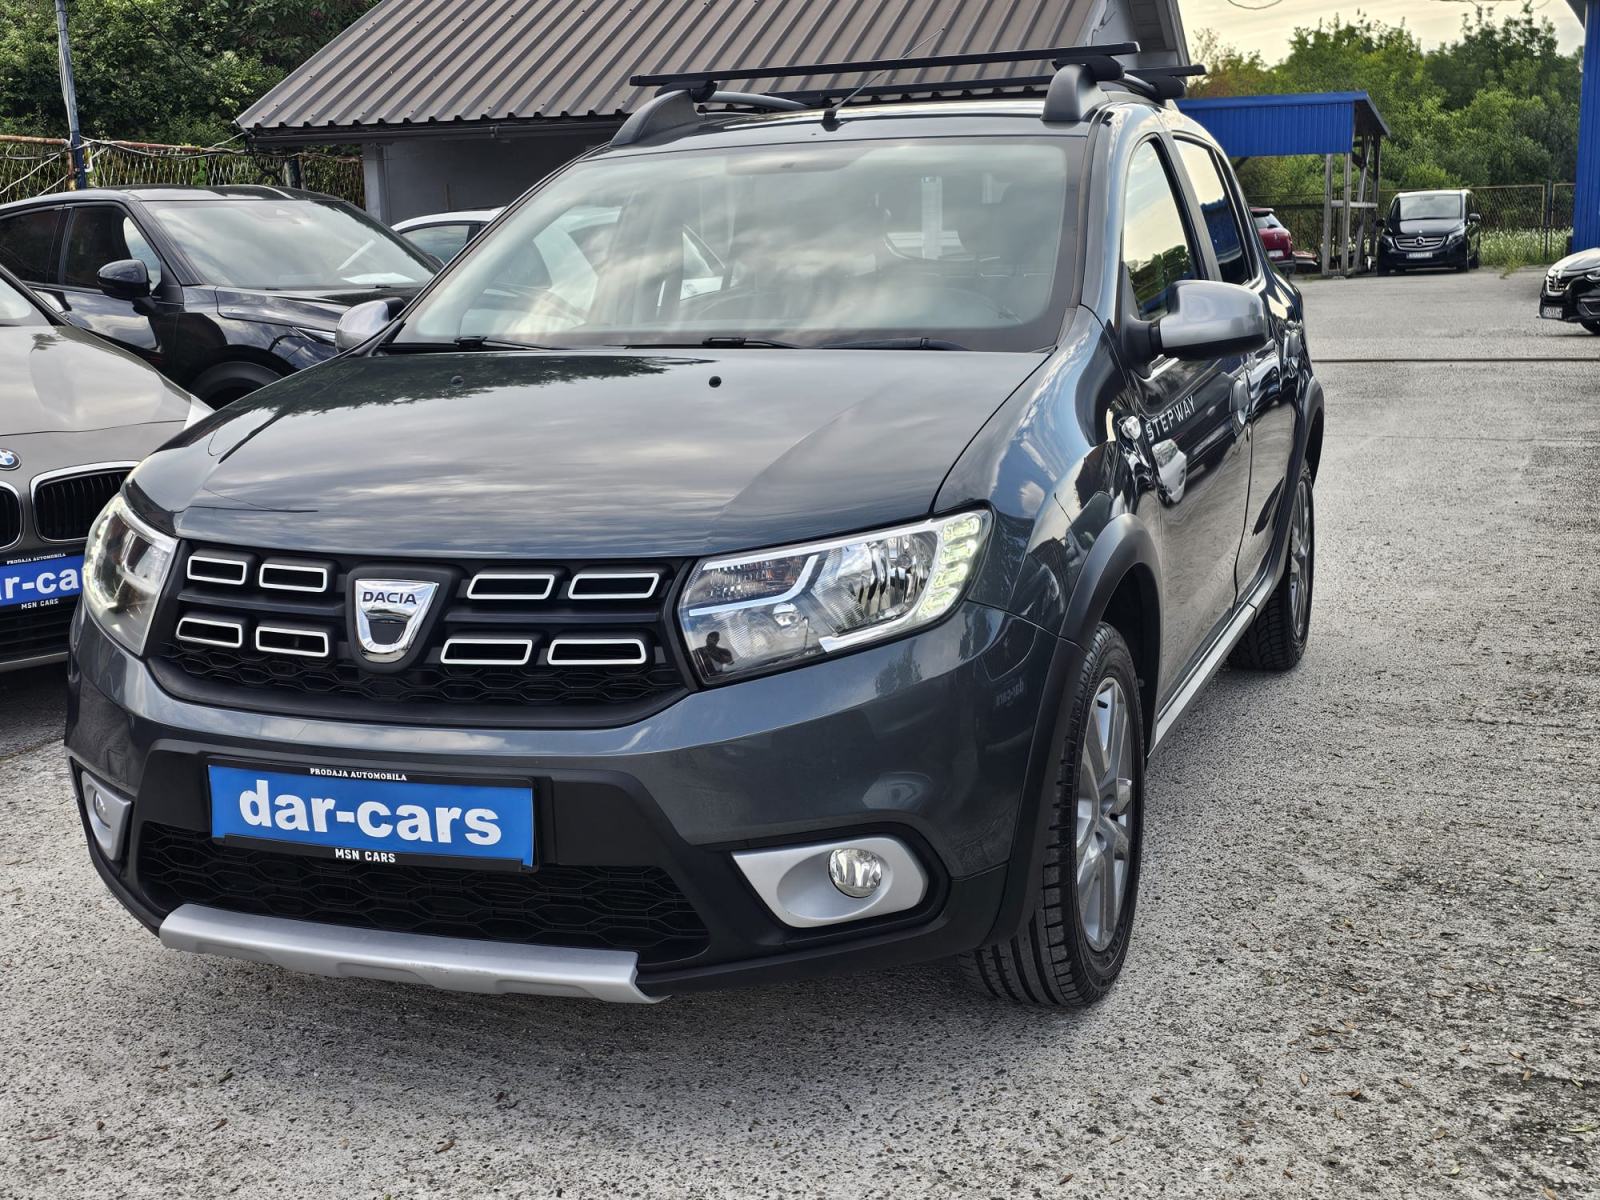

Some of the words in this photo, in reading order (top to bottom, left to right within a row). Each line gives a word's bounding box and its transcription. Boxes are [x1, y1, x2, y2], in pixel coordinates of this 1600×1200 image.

[1145, 395, 1196, 442] STEPWAY
[0, 568, 79, 600] r-ca
[21, 602, 37, 610] MSN
[40, 599, 59, 607] CARS
[362, 591, 417, 605] DACIA
[310, 767, 349, 778] PRODAJA
[350, 770, 407, 782] AUTOMOBILA
[239, 779, 502, 846] dar-cars
[335, 848, 360, 861] MSN
[365, 850, 396, 864] CARS
